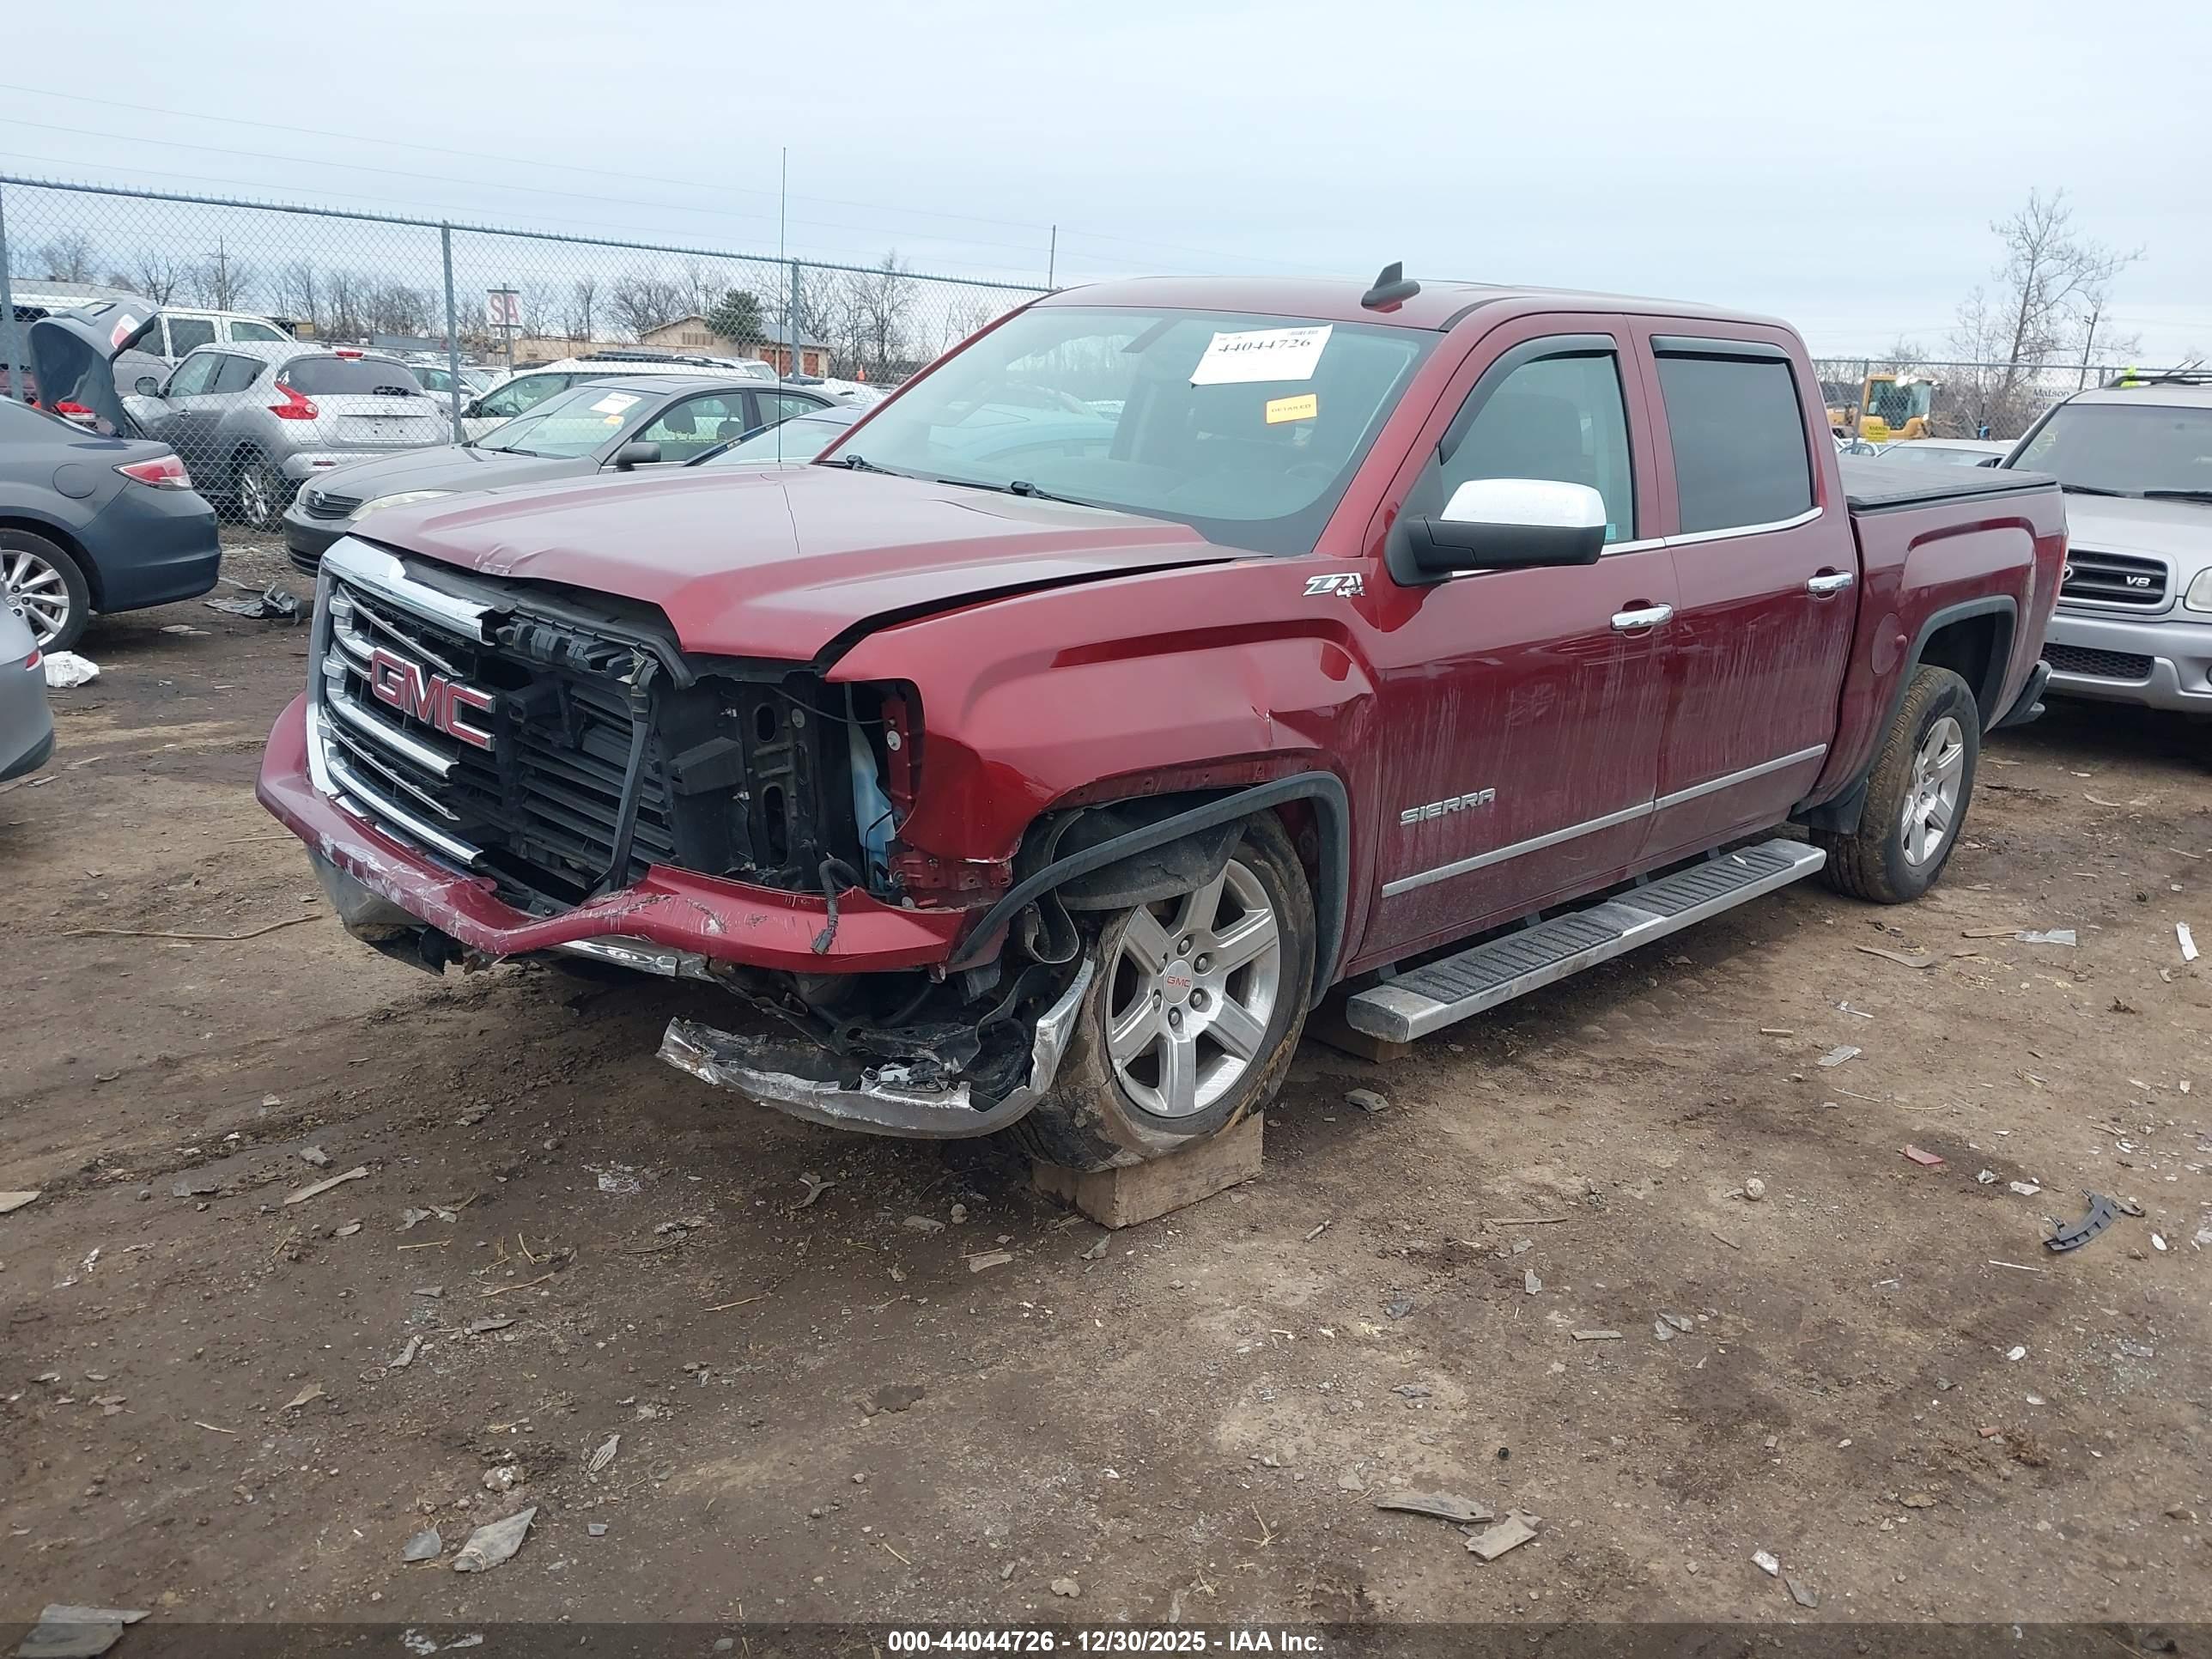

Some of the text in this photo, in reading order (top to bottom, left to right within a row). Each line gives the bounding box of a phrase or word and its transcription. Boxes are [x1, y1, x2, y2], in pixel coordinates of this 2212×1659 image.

[1218, 338, 1311, 353] 44044726
[2126, 575, 2150, 586] V8
[372, 646, 495, 752] GMC
[1400, 787, 1496, 826] SIERRA
[1167, 975, 1191, 988] GMC
